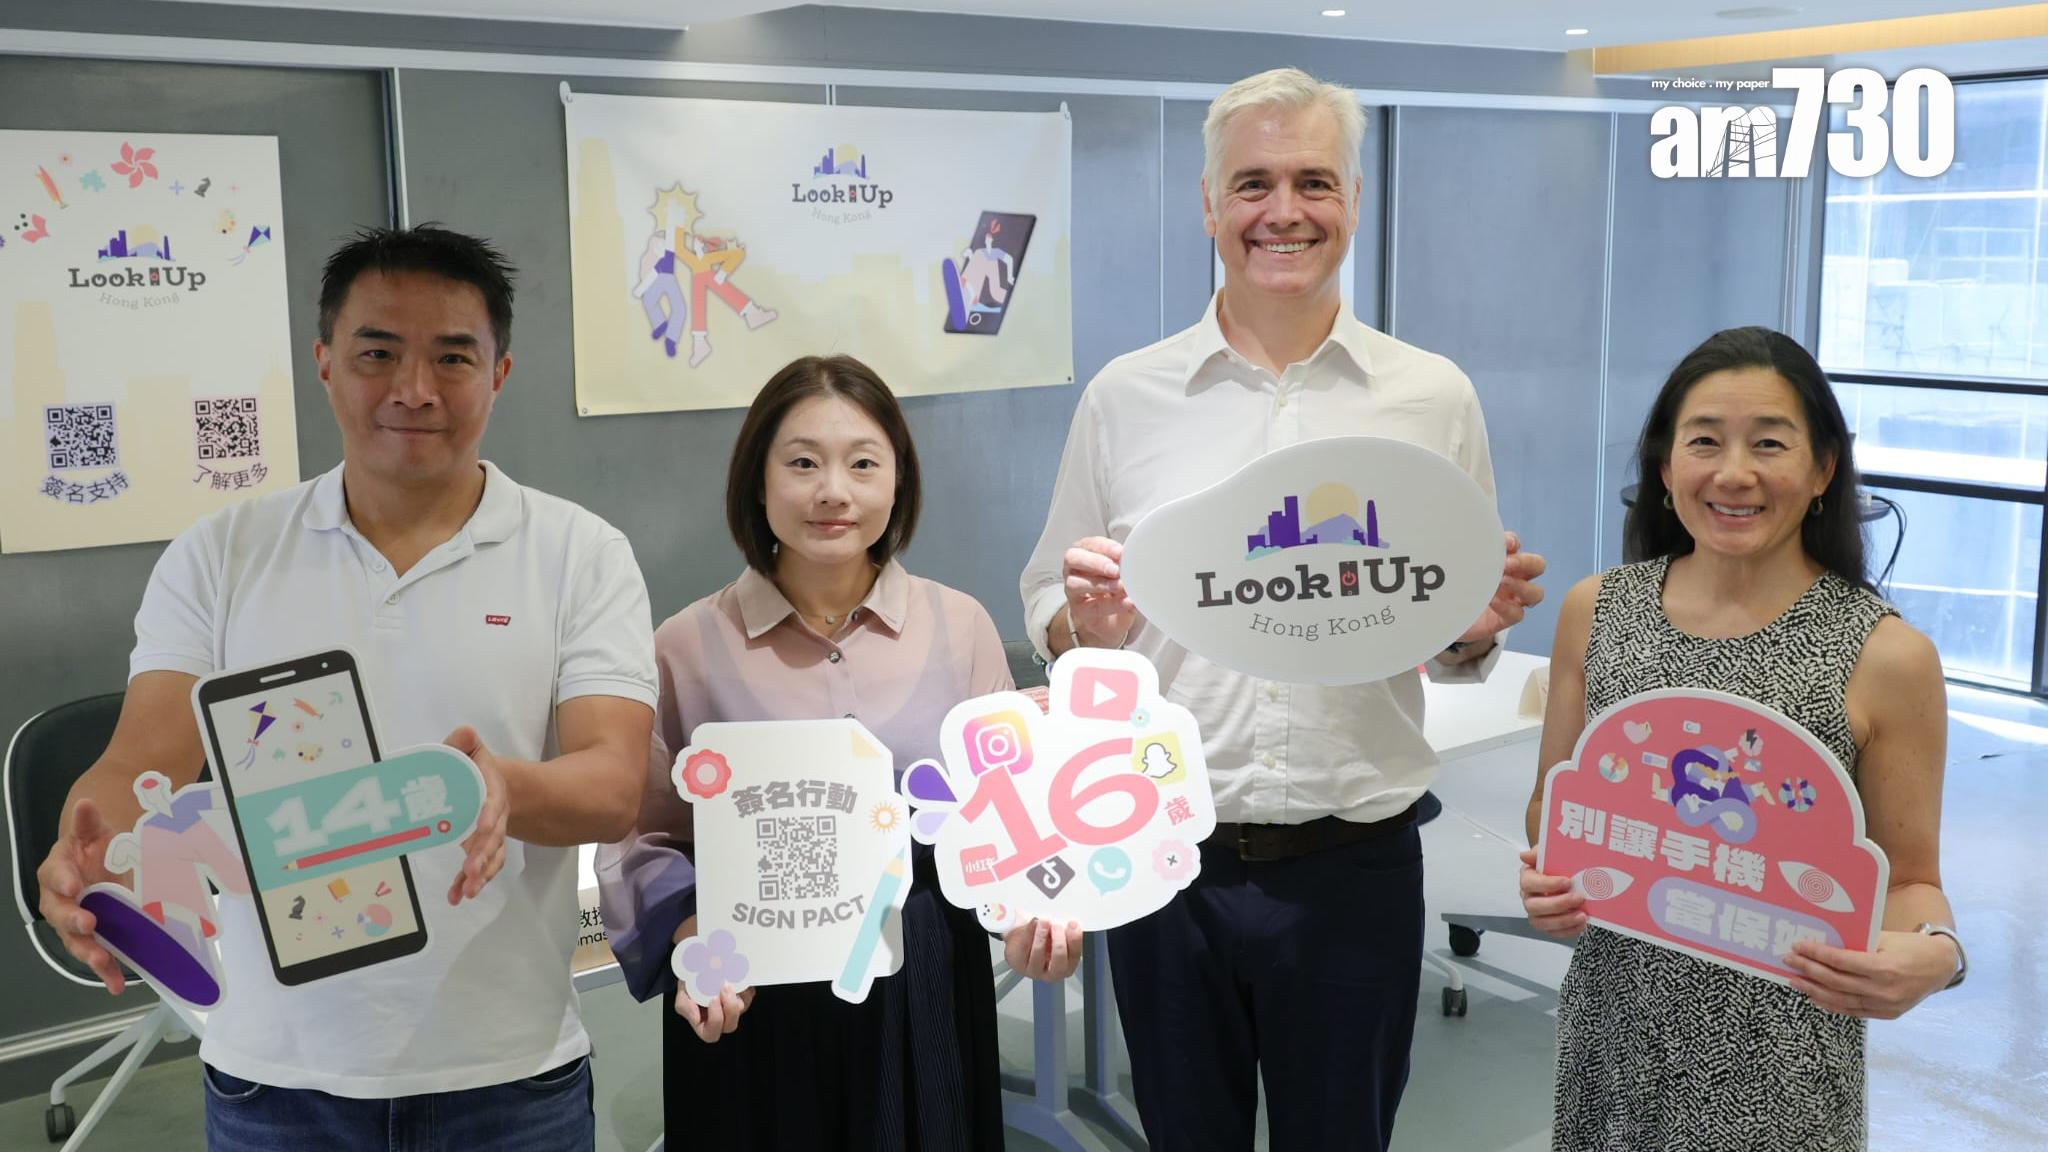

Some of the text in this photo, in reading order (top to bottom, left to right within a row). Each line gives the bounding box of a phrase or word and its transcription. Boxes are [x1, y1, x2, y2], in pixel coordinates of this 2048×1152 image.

[792, 183, 893, 208] Look Up
[68, 266, 206, 291] Look Up
[100, 291, 180, 310] Hong Kong
[42, 472, 128, 503] 簽名支持
[193, 463, 268, 490] 了解更多
[1195, 556, 1446, 608] Look Up
[1249, 605, 1395, 641] Hong Kong
[731, 779, 858, 818] 簽名行動
[1558, 800, 1766, 892] 別讓手機
[732, 895, 865, 929] SIGN PACT
